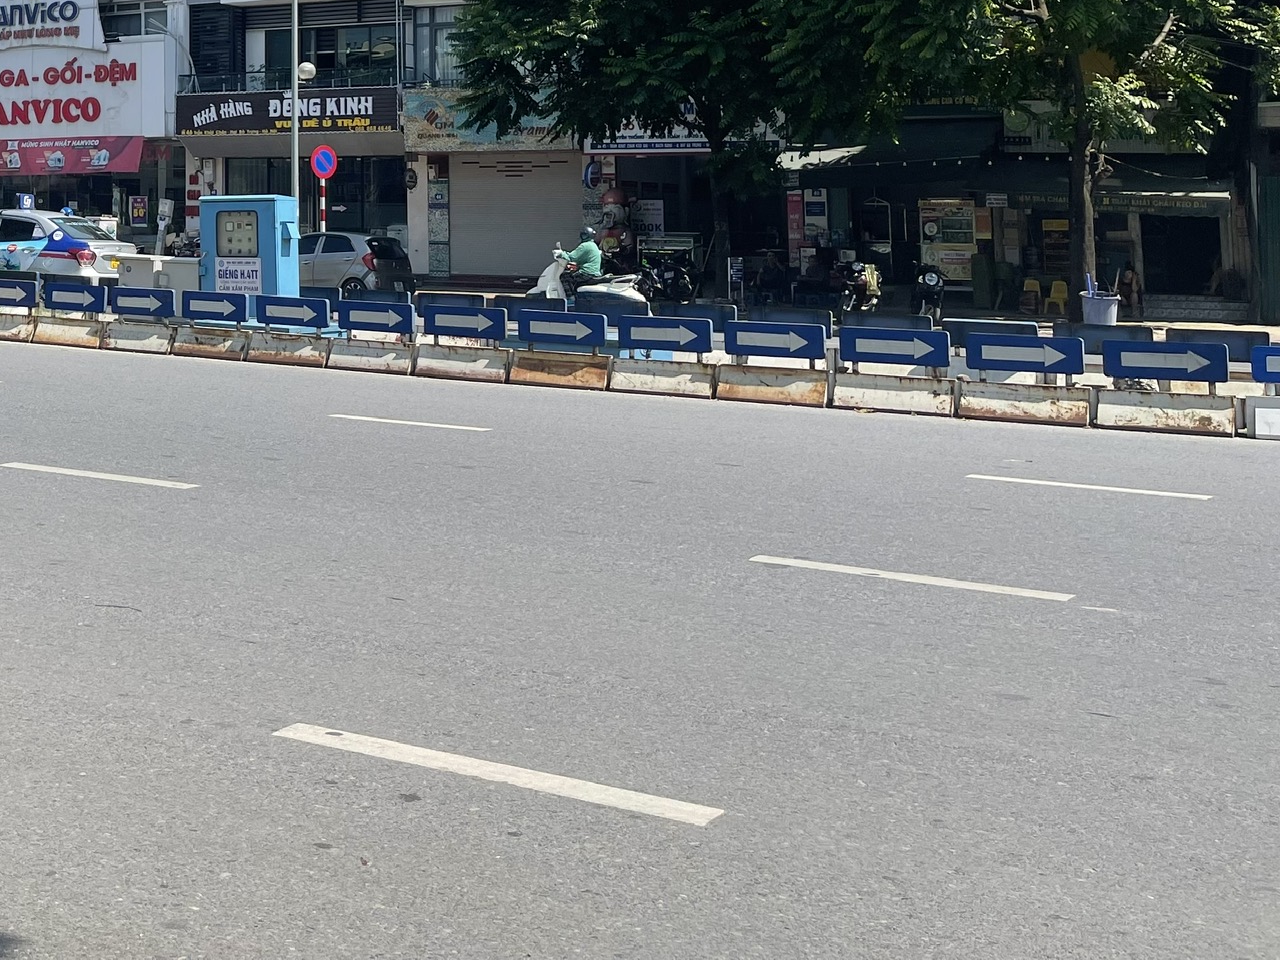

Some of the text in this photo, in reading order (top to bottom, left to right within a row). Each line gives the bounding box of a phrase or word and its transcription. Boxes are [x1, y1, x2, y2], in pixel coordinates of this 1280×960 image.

[0, 69, 29, 87] GA
[43, 57, 83, 85] GỐI
[94, 59, 137, 86] ĐỆM
[192, 103, 219, 127] NHÀ
[220, 99, 253, 119] HÀNG
[326, 96, 373, 116] KINH
[275, 119, 300, 129] VU
[71, 139, 100, 147] HANVICO
[218, 266, 239, 279] GIẾNG
